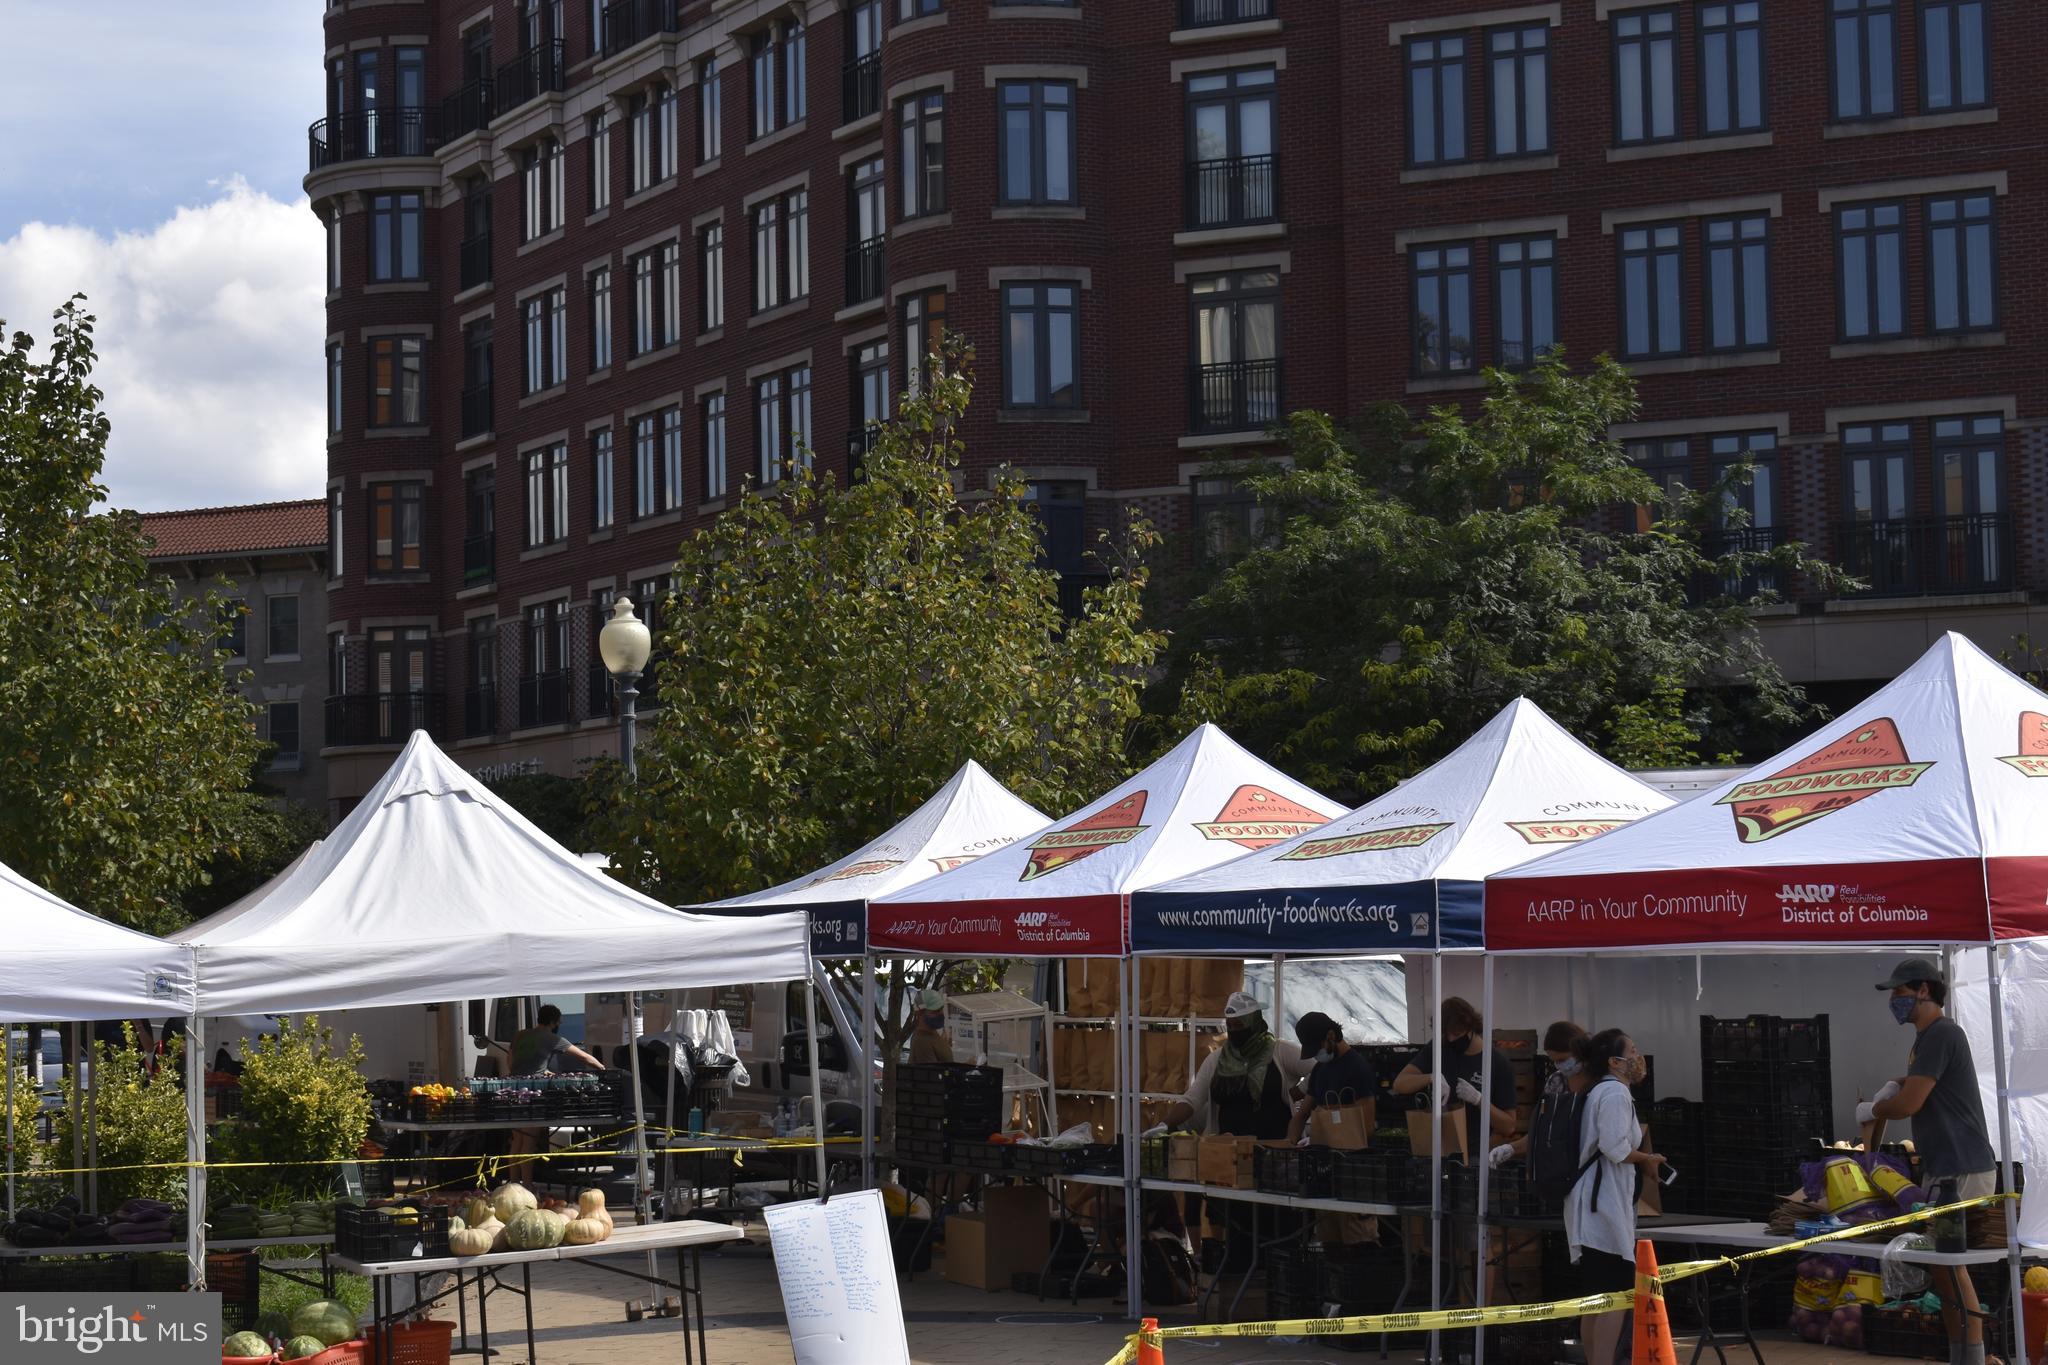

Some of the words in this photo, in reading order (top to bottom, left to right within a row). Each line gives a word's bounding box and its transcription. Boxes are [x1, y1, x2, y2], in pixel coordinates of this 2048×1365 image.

[1796, 746, 1892, 770] COMMUNITY
[1731, 767, 1917, 799] FOODWORKS
[1231, 805, 1312, 818] COMMUNITY
[1542, 800, 1657, 816] COMMUNI
[1346, 806, 1440, 831] COMMUNITY
[1037, 829, 1138, 846] FOODWORKS
[1207, 824, 1314, 836] FOODWO
[1290, 829, 1434, 857] FOODWORKS
[1775, 884, 1836, 903] AARP
[1839, 883, 1859, 894] Real
[1527, 899, 1575, 923] AARP
[1580, 898, 1595, 921] in
[1599, 897, 1638, 920] Your
[1643, 889, 1748, 917] Community
[1840, 893, 1886, 904] Possibilities
[1014, 912, 1048, 927] AARP
[1157, 895, 1399, 934] www.community-foodworks.org
[1782, 906, 1835, 923] District
[1839, 905, 1854, 923] of
[1859, 904, 1928, 922] Columbia
[885, 920, 917, 934] AARP
[914, 919, 925, 934] in
[927, 919, 948, 936] Your
[949, 914, 1002, 936] Community
[1017, 929, 1044, 941] District
[1046, 928, 1054, 942] of
[1055, 927, 1090, 941] Columbia
